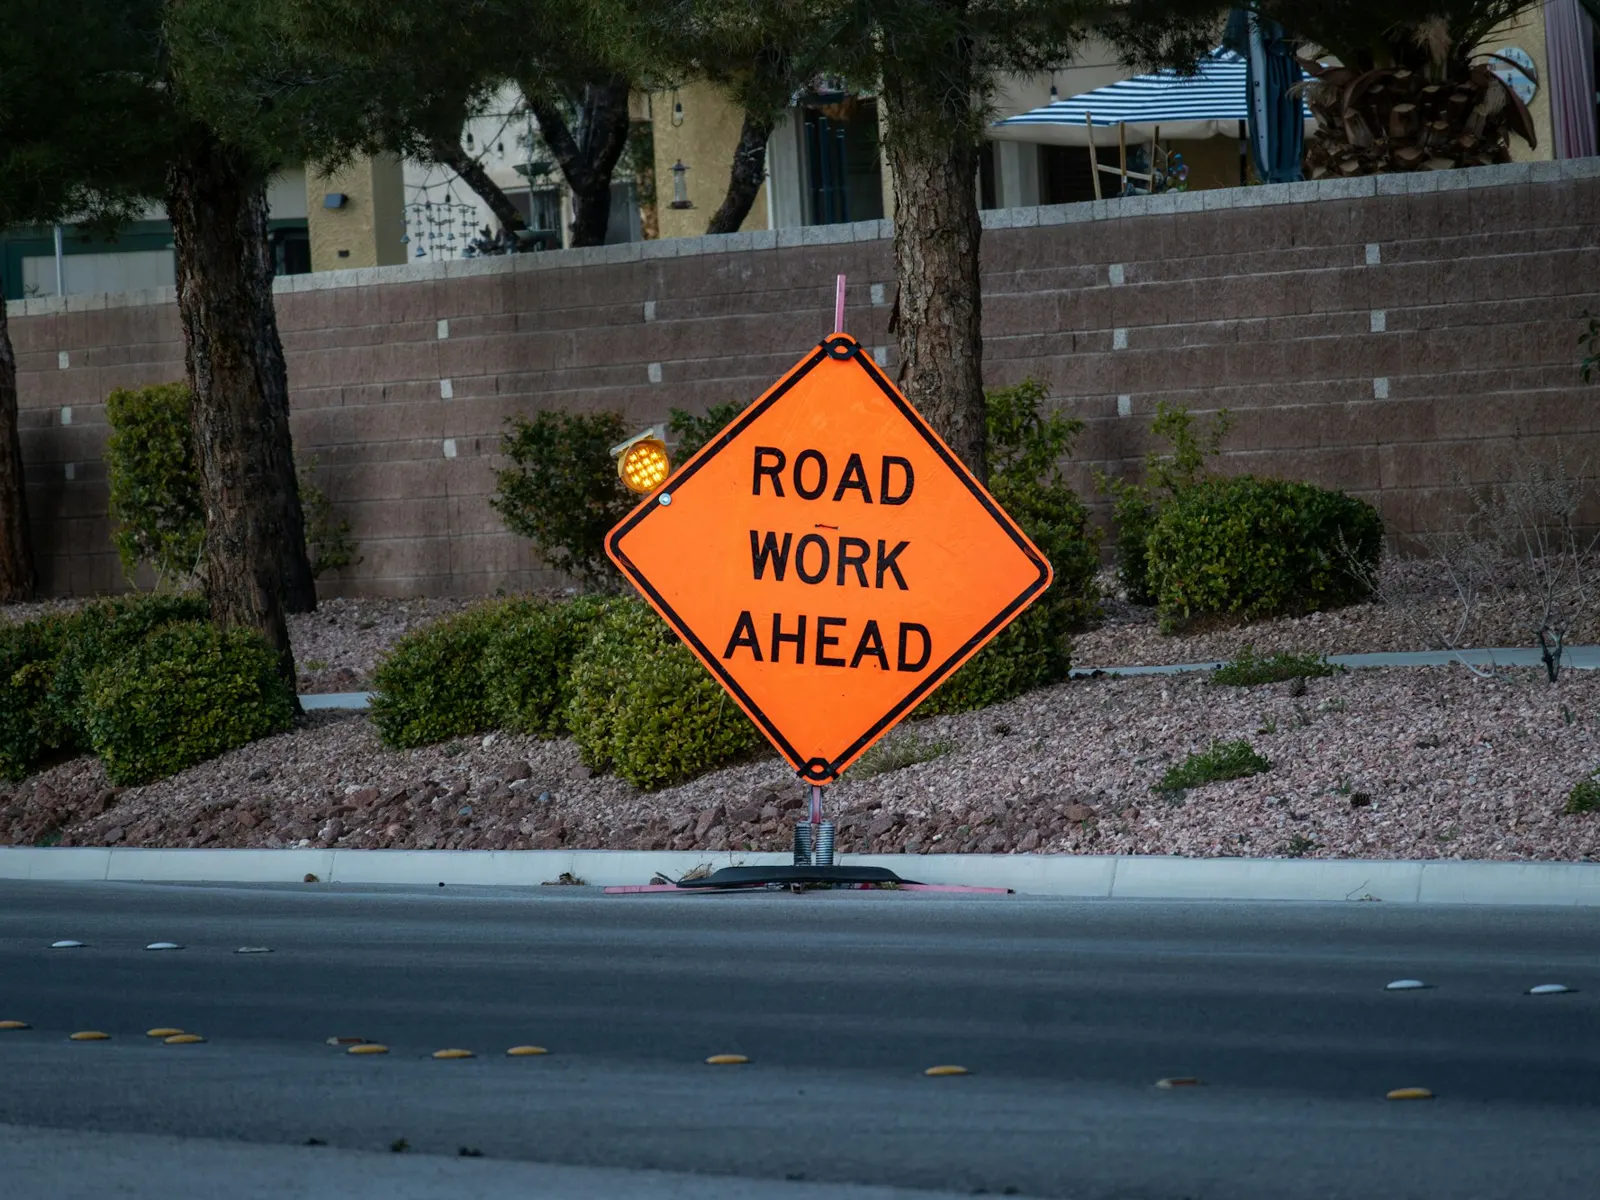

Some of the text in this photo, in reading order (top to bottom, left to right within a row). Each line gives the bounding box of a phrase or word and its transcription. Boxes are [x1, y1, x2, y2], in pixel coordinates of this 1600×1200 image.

[752, 446, 914, 506] ROAD
[750, 530, 910, 590] WORK
[723, 611, 932, 673] AHEAD
